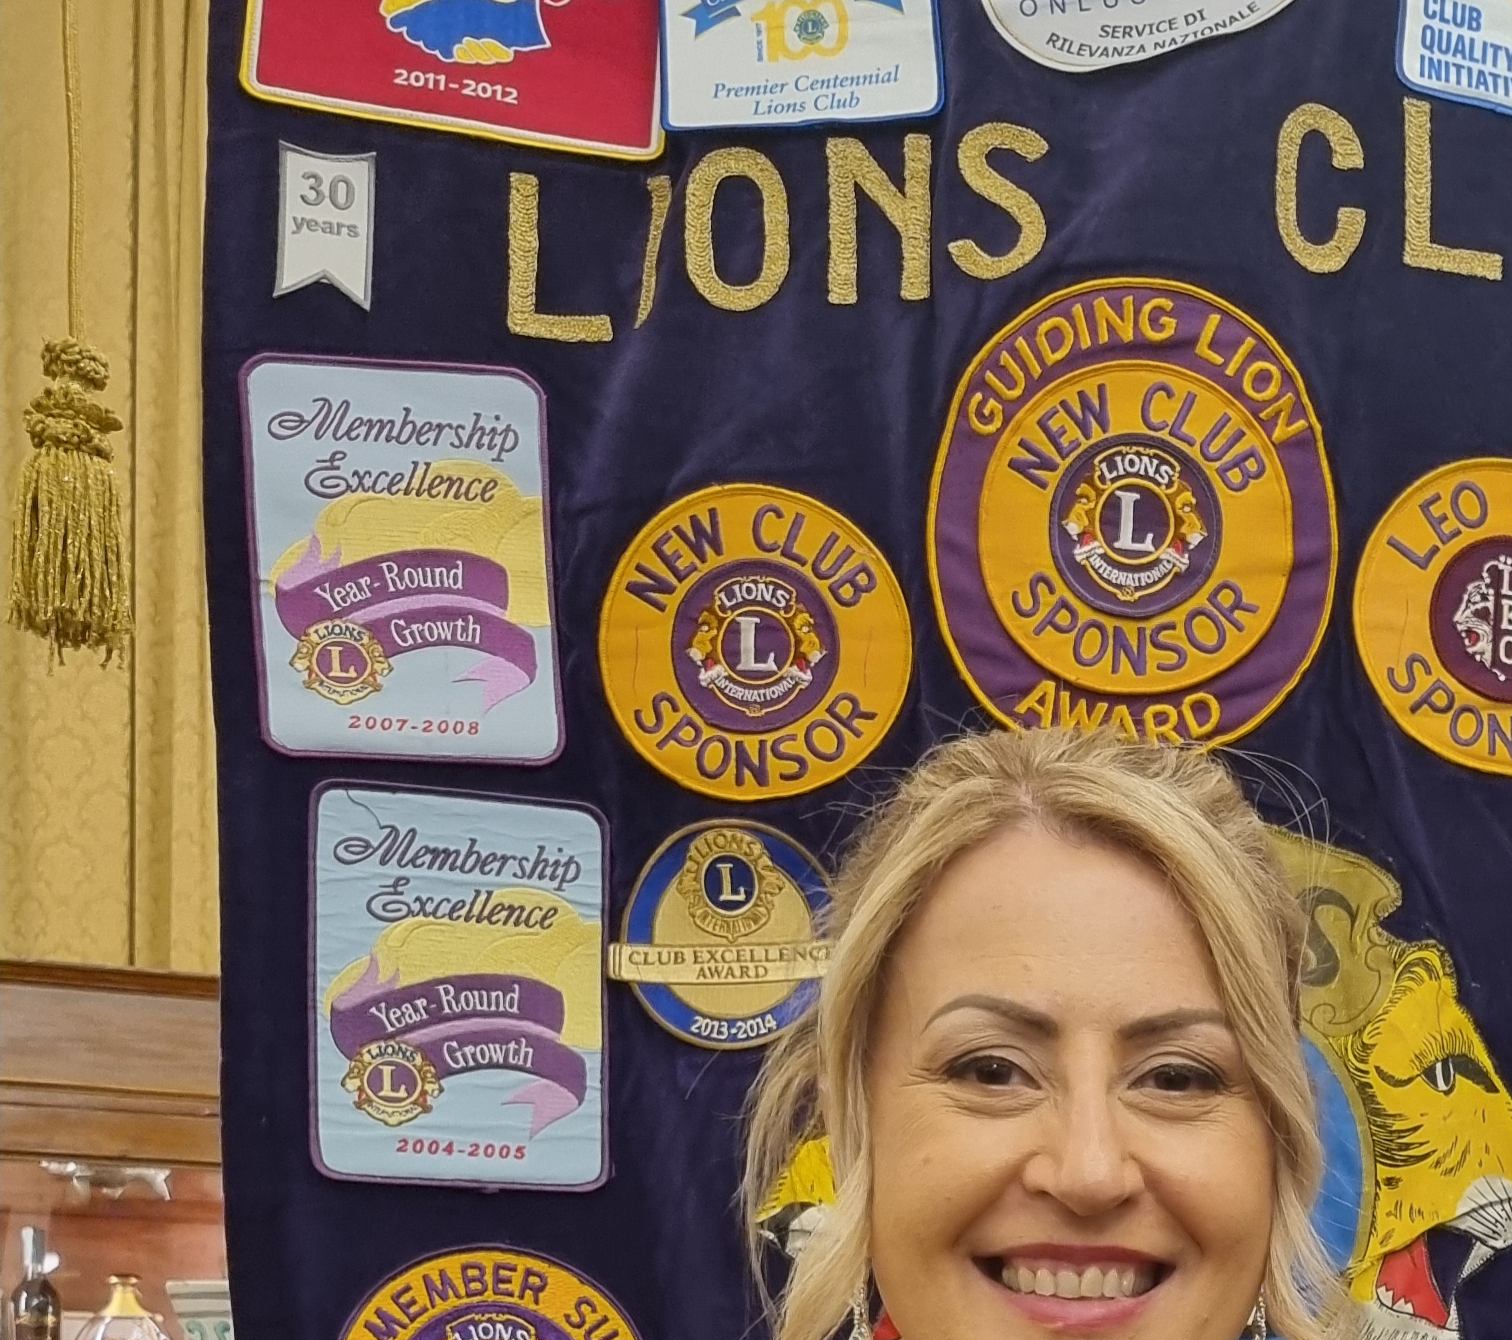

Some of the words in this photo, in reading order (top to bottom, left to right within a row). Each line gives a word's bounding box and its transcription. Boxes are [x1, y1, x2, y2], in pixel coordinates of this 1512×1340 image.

[1098, 17, 1179, 39] SERVICE
[1184, 8, 1208, 27] DI
[1423, 0, 1483, 32] CLUB
[1046, 32, 1147, 58] RILEVANZA
[394, 69, 519, 104] 2011-2012
[713, 79, 789, 99] Premier
[794, 64, 900, 92] Centennial
[753, 100, 806, 116] Lions
[813, 91, 860, 111] Club
[299, 171, 356, 211] 30
[291, 212, 361, 240] years
[507, 121, 1049, 342] LIONS
[967, 295, 1178, 436] GUIDING
[1194, 313, 1309, 445] LION
[267, 396, 520, 463] Membership
[1007, 382, 1111, 491] NEW
[1140, 381, 1266, 492] CLUB
[304, 450, 498, 502] Excellence
[1101, 453, 1174, 485] LIONS
[1112, 490, 1155, 553] L
[1385, 480, 1488, 571] LEO
[624, 507, 725, 614] NEW
[752, 503, 877, 608] CLUB
[1089, 550, 1174, 588] INTERNATIONAL
[314, 560, 465, 612] Year-Round
[718, 582, 791, 610] LIONS
[313, 624, 365, 641] LIONS
[390, 614, 482, 648] Growth
[1011, 571, 1260, 677] SPONSOR
[735, 616, 779, 671] L
[326, 646, 357, 678] L
[714, 676, 797, 702] INTERNATIONAL
[347, 714, 480, 736] 2007-2008
[1015, 679, 1221, 747] AWARD
[633, 691, 878, 788] SPONSOR
[332, 824, 582, 892] Membership
[697, 832, 758, 857] LIONS
[716, 863, 746, 901] L
[365, 876, 559, 930] Excellence
[628, 950, 686, 966] CLUB
[696, 965, 769, 980] AWARD
[369, 983, 520, 1033] Year-Round
[690, 1014, 777, 1040] 2013-2014
[366, 1044, 417, 1062] LIONS
[443, 1038, 534, 1071] Growth
[378, 1065, 408, 1097] L
[395, 1138, 527, 1161] 2004-2005
